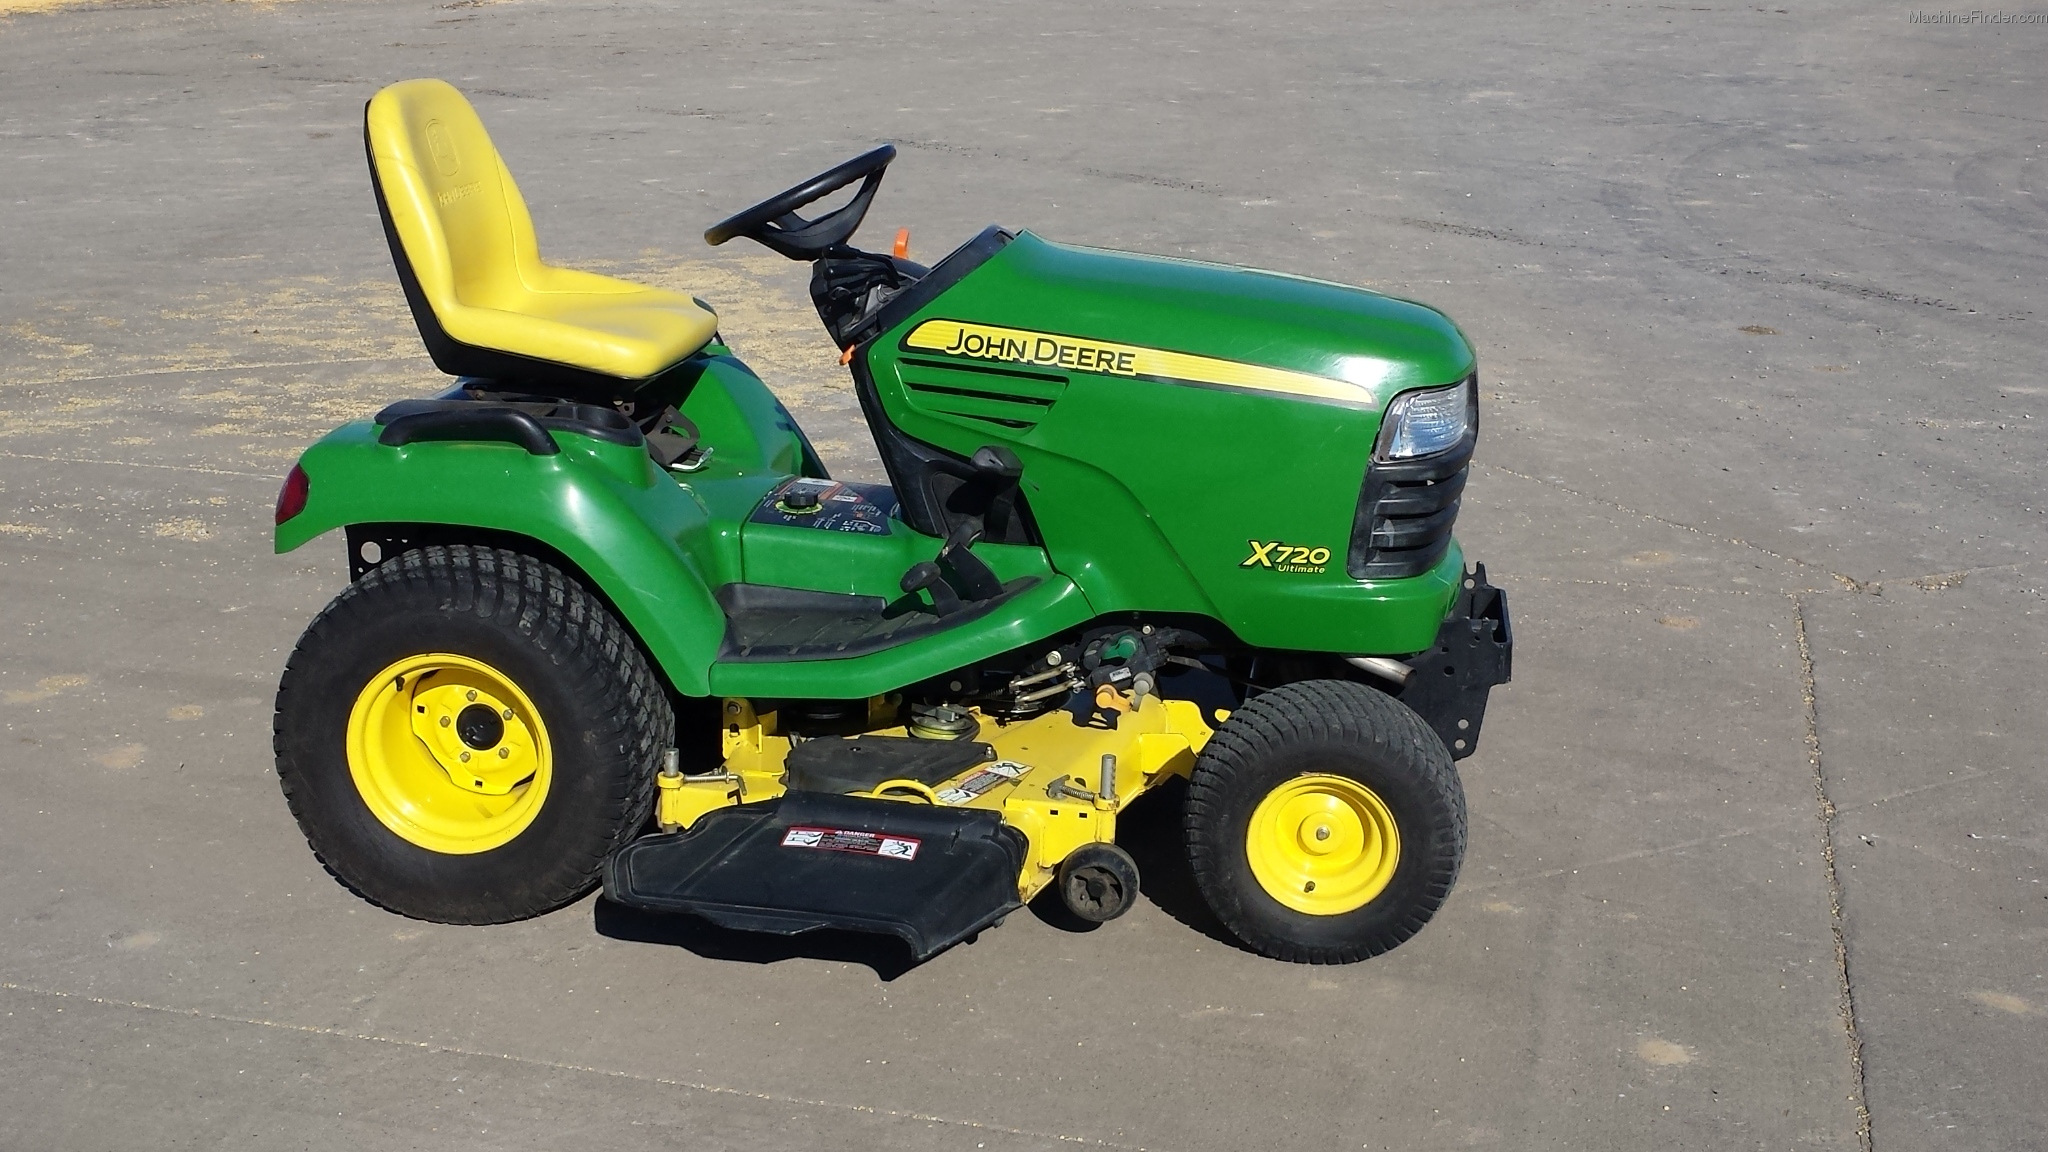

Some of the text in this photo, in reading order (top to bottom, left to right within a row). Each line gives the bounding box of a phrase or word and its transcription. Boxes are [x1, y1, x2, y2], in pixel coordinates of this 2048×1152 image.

[945, 328, 1137, 372] JOHN DEERE
[1240, 540, 1331, 568] X720
[1277, 564, 1326, 574] Ultimate
[843, 830, 876, 838] DANGER
